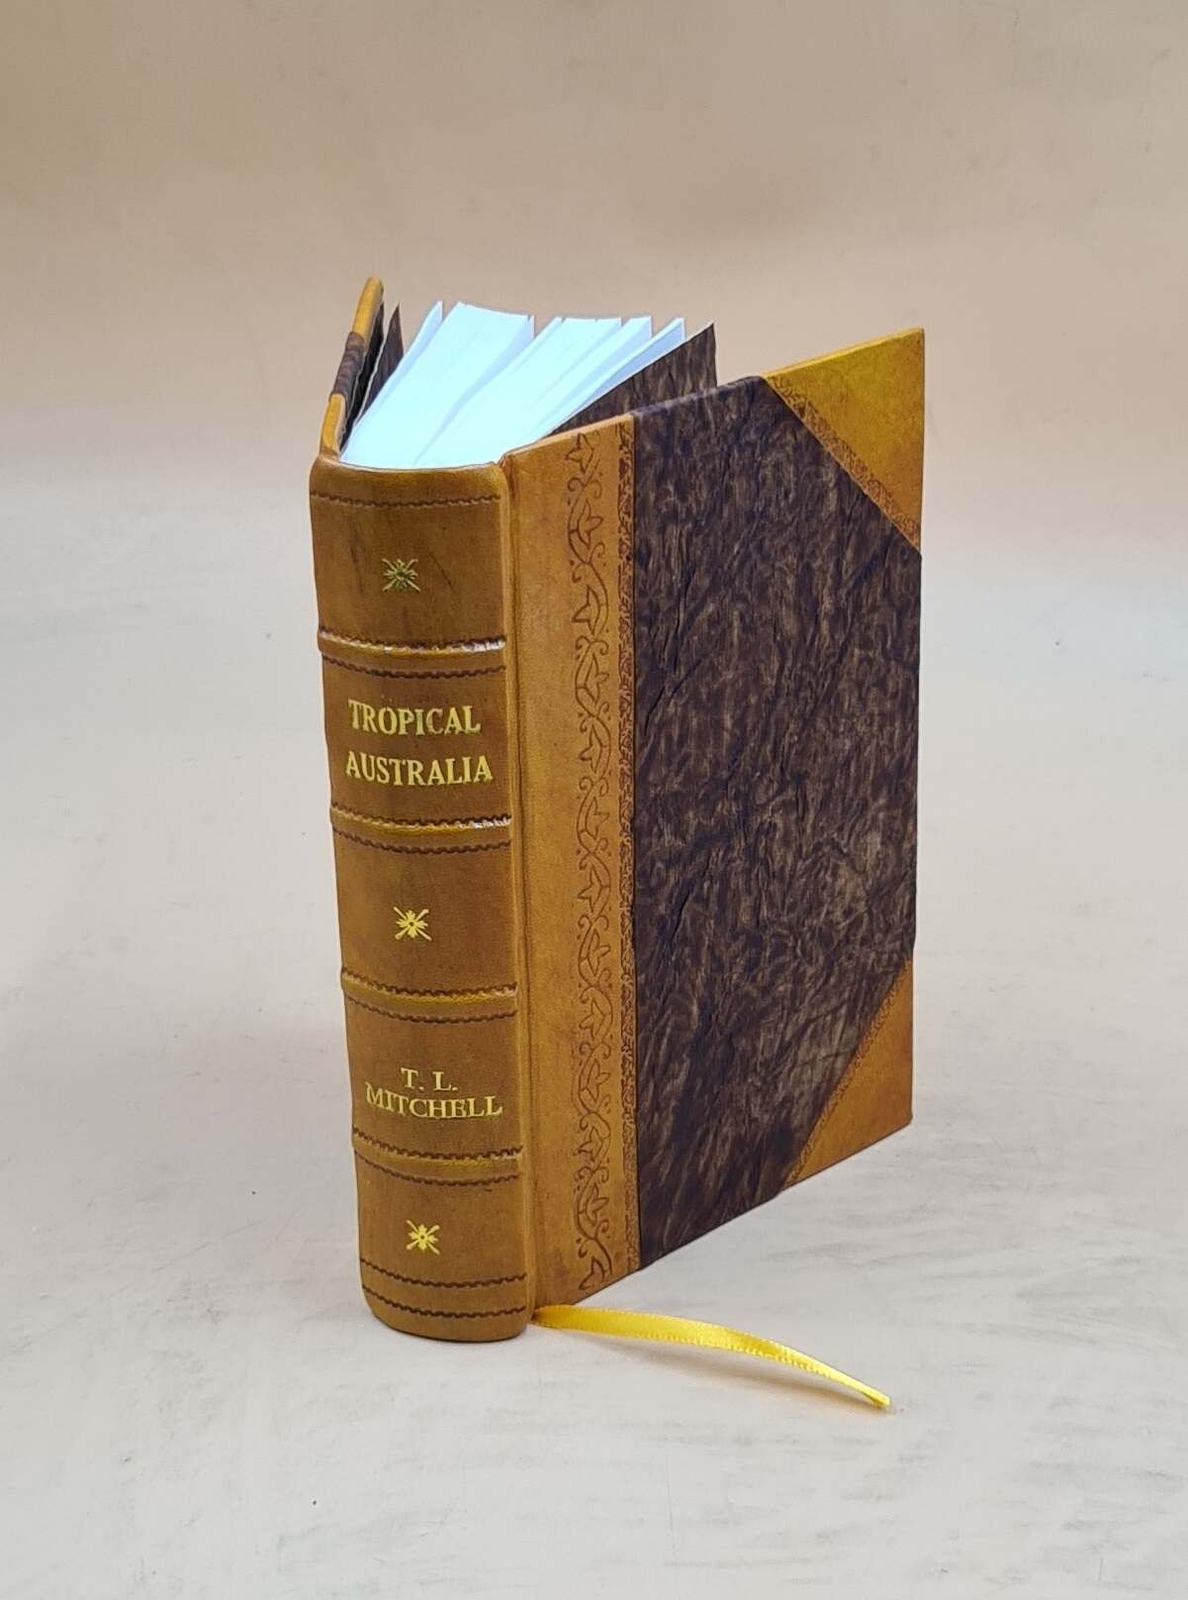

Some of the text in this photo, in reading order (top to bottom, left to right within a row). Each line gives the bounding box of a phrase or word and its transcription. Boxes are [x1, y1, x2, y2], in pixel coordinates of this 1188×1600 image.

[348, 699, 481, 735] TROPICAL
[346, 751, 493, 786] AUSTRALIA
[401, 1067, 459, 1091] T. L.
[364, 1082, 503, 1118] MITCHELL
